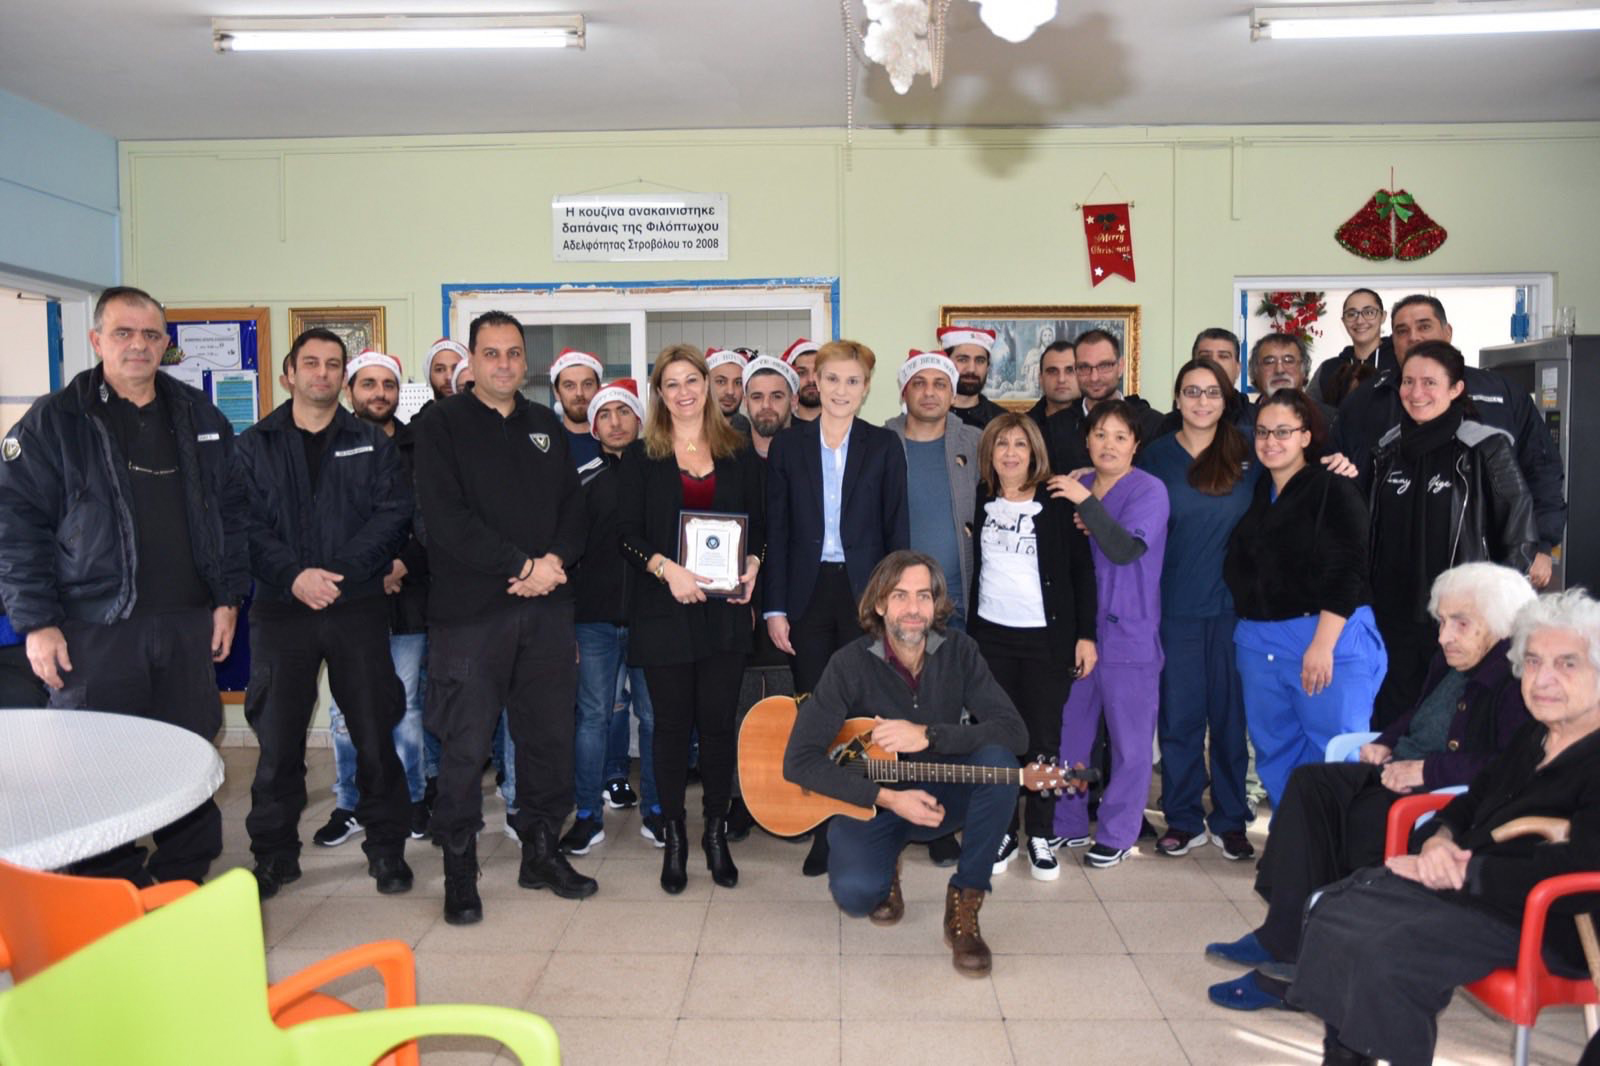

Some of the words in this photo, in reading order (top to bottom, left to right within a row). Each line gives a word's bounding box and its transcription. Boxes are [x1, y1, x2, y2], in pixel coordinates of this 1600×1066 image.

[566, 207, 575, 217] Η
[579, 206, 625, 219] κουζίνα
[562, 222, 618, 235] δαπάναις
[622, 223, 642, 235] της
[646, 220, 719, 234] Φιλόπτωχου
[1096, 233, 1125, 243] Merry
[563, 239, 625, 252] Αδελφότητας
[628, 238, 680, 251] Στροβόλου
[682, 240, 693, 248] το
[695, 238, 719, 249] 2008
[1090, 245, 1130, 255] Chrismas
